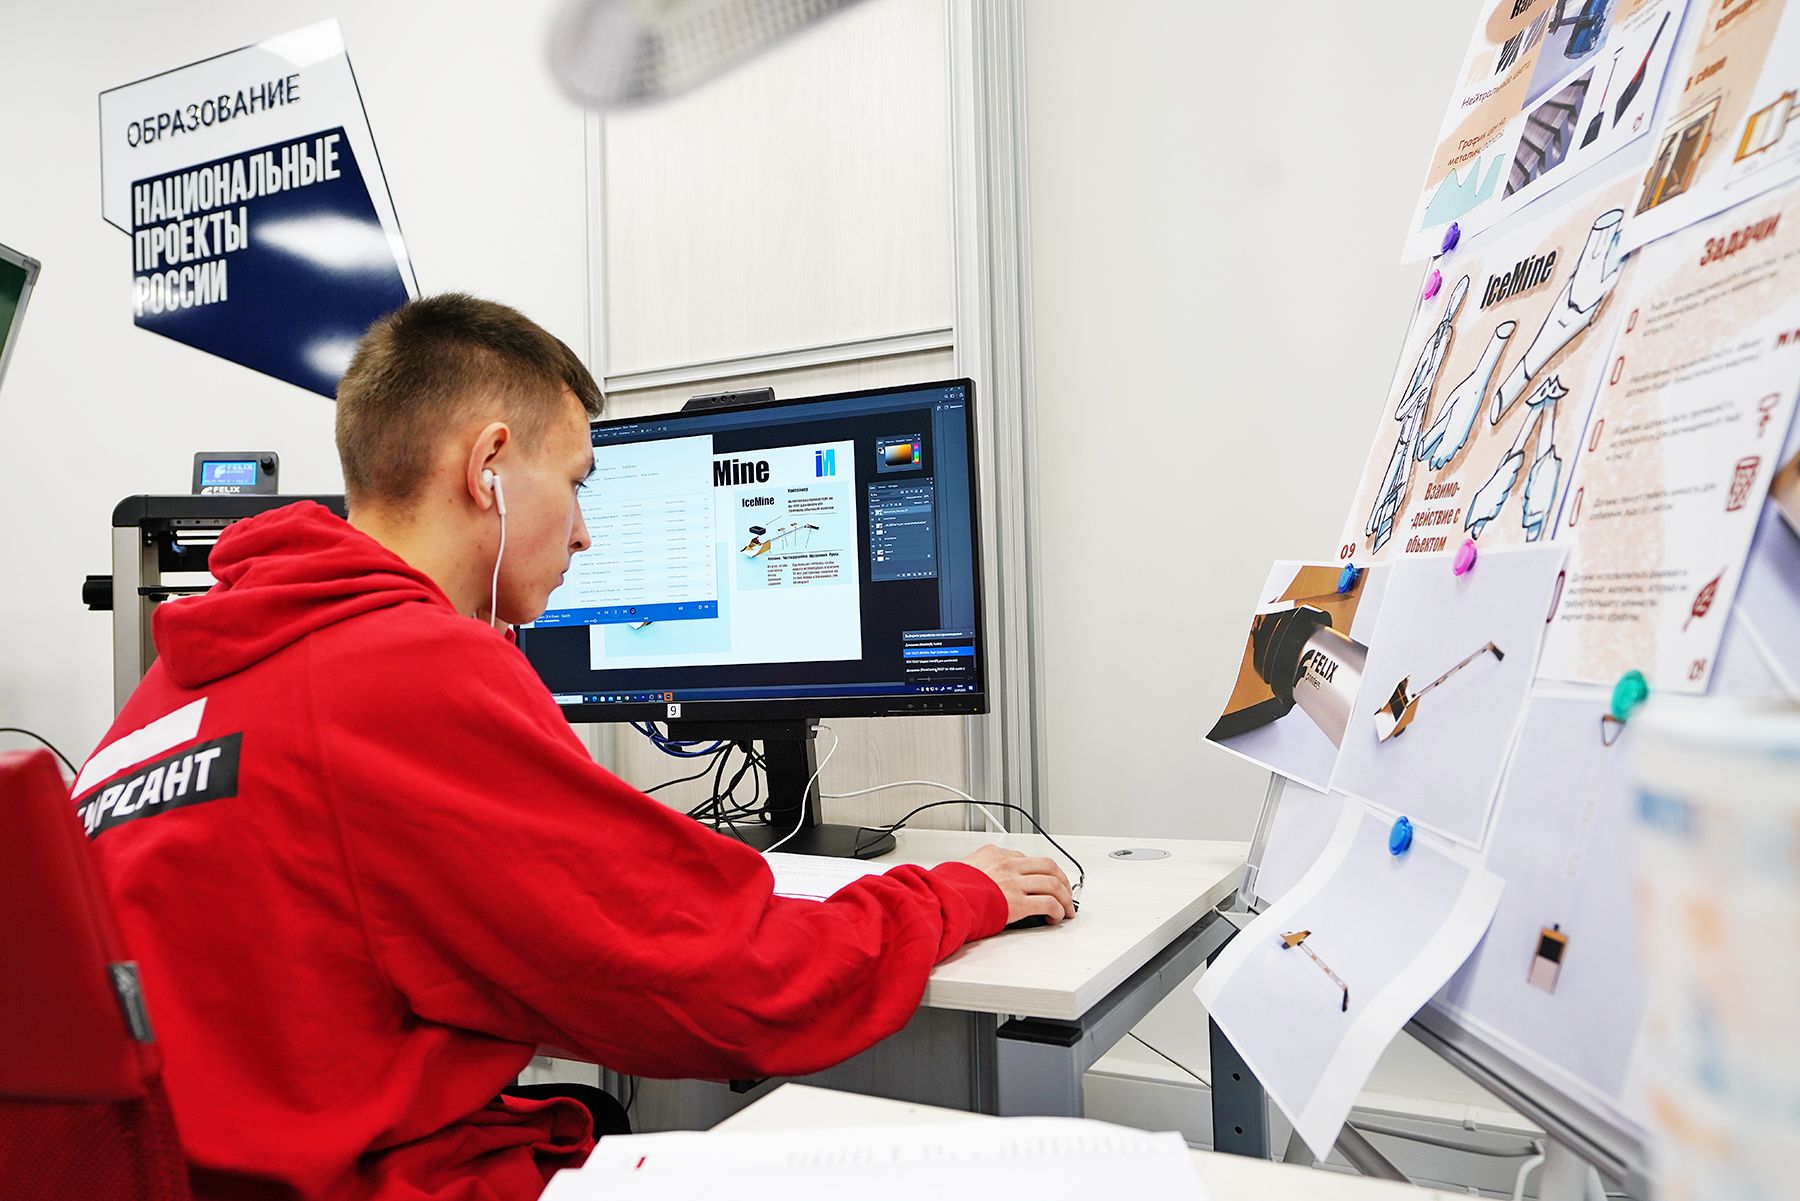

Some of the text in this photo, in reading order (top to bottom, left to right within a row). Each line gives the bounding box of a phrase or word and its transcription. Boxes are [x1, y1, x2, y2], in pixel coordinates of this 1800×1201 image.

[127, 73, 301, 148] ОБРАЗОВАНИЕ
[134, 134, 341, 227] НАЦИОНАЛЬНЫЕ
[135, 206, 248, 272] ПРОЕКТЫ
[134, 258, 228, 317] РОССИИ
[1480, 250, 1557, 310] IceMine
[713, 459, 770, 487] Mine
[742, 496, 775, 508] IceMine
[1424, 481, 1460, 501] Взаимо-
[1411, 508, 1454, 529] -действие
[1340, 542, 1356, 560] 09
[1405, 535, 1448, 553] объектом
[1310, 651, 1339, 683] FELIX
[669, 705, 677, 717] 9
